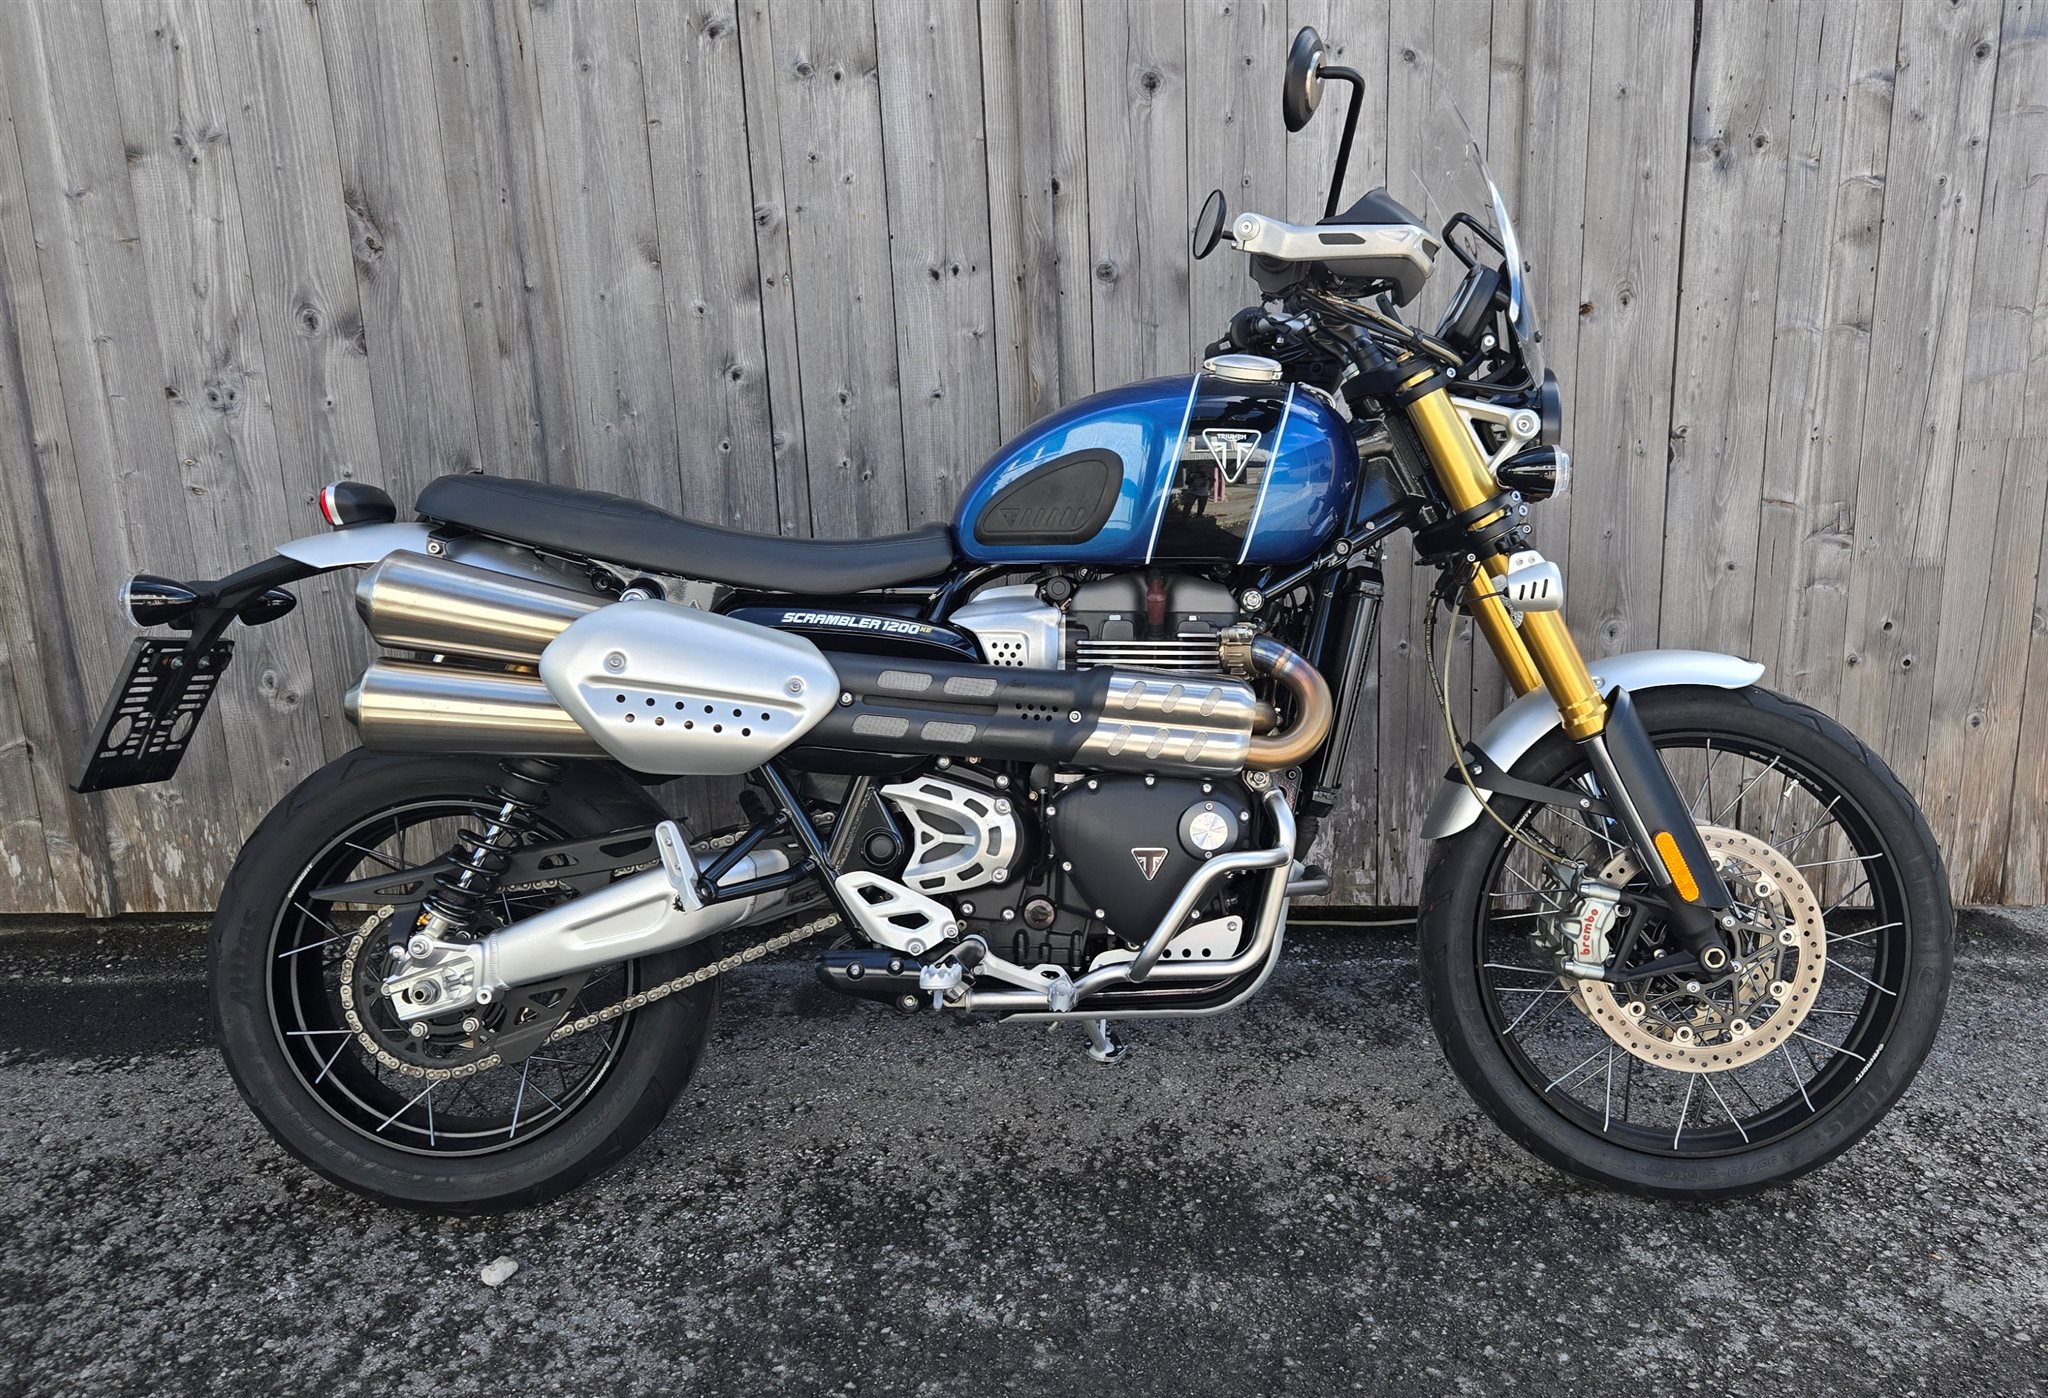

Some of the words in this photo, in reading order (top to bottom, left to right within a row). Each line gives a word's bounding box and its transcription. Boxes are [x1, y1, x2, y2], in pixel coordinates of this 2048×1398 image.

[1216, 433, 1247, 441] TRIUMPH
[781, 612, 881, 630] SCRAMBLER
[881, 620, 920, 635] 1200
[1580, 908, 1599, 957] brembo
